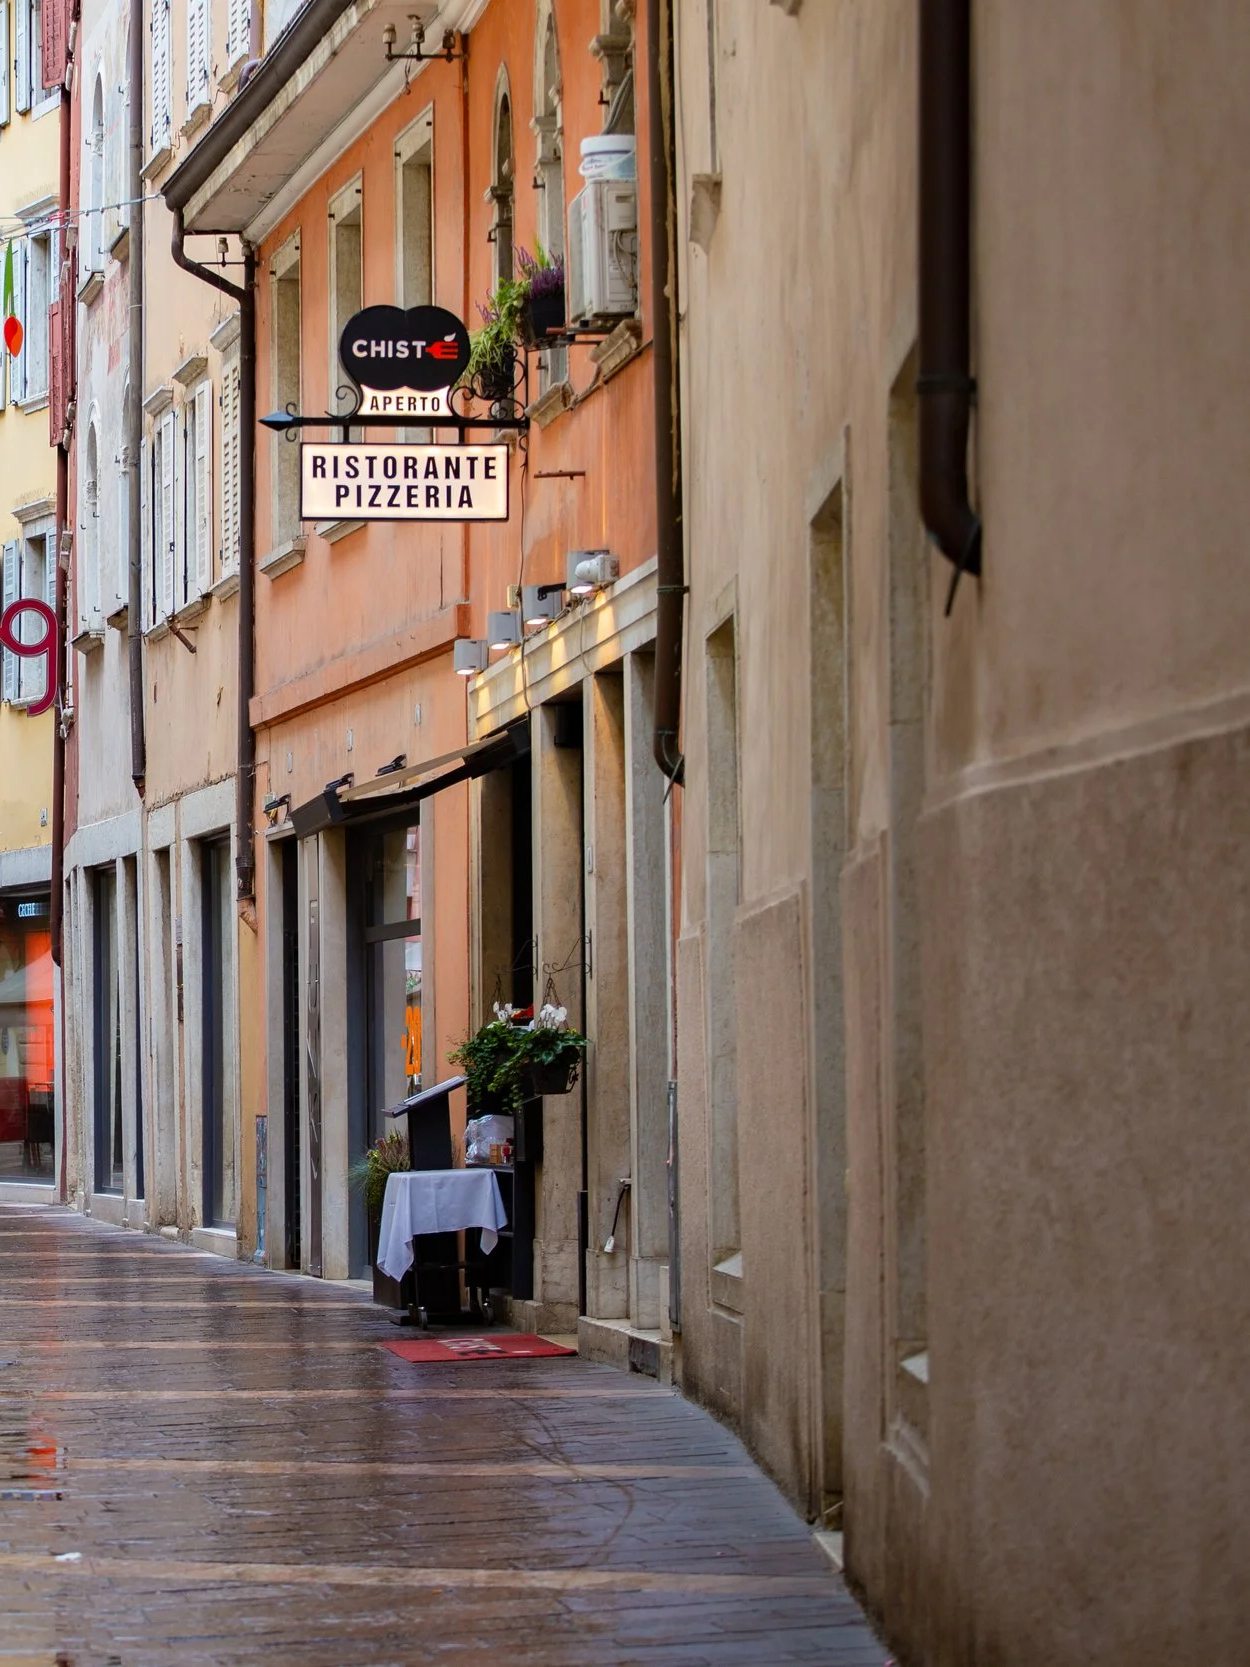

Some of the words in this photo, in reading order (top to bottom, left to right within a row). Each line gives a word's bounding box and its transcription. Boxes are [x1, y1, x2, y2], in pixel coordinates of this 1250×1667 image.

[370, 396, 441, 411] APERTO
[312, 456, 497, 479] RISTORANTE
[335, 485, 474, 508] PIZZERIA
